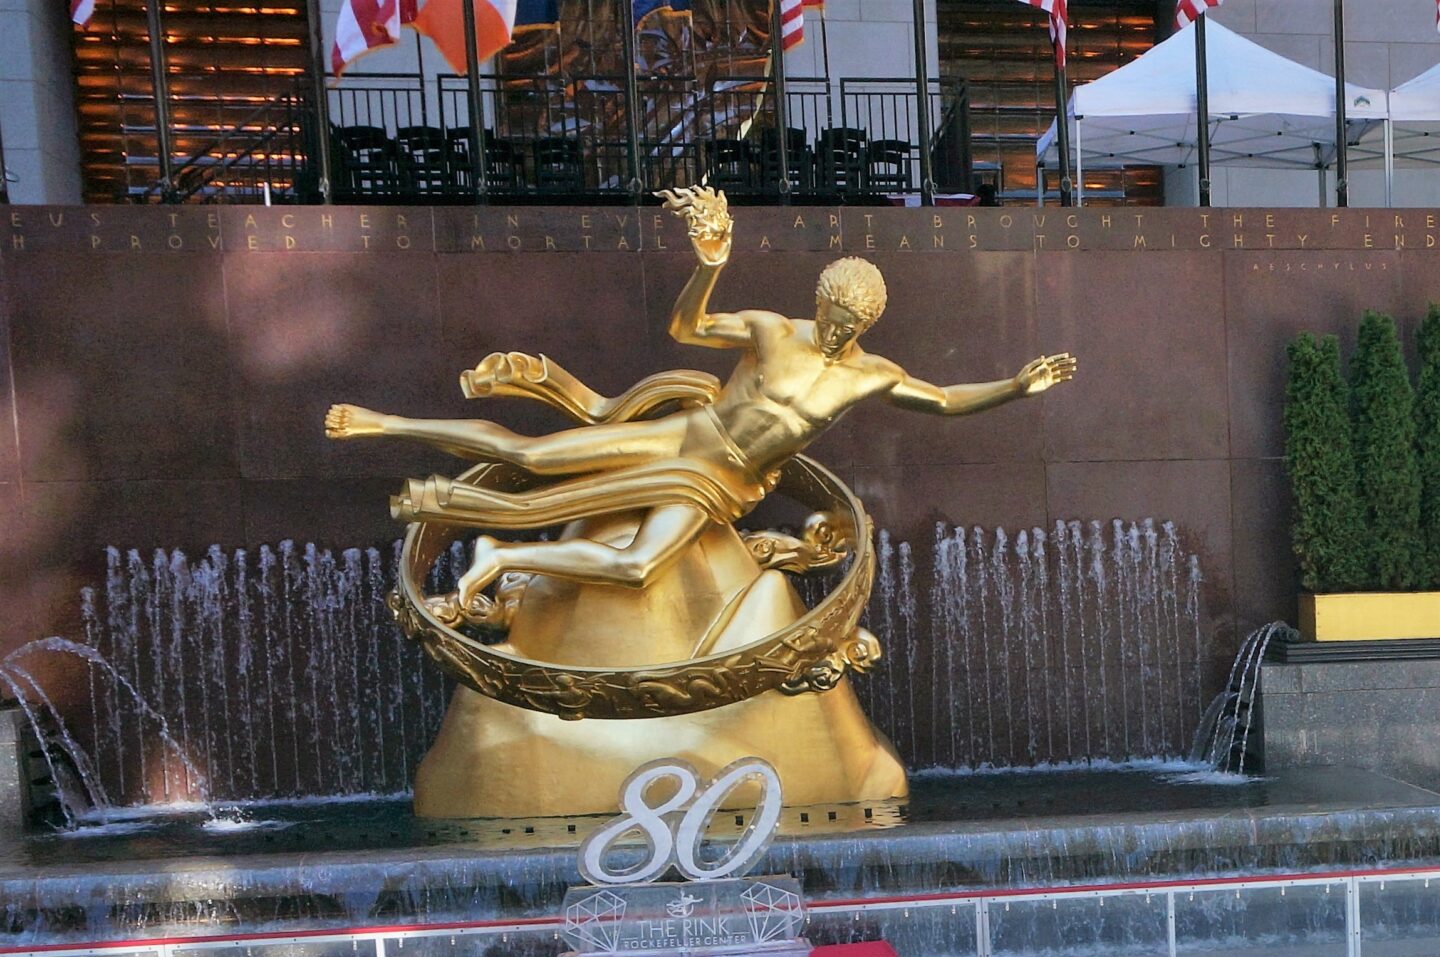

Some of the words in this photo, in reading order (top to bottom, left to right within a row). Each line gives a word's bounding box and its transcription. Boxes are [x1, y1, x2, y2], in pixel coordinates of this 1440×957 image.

[168, 213, 408, 228] TEACHER
[473, 214, 519, 228] IN
[581, 214, 664, 228] EVE
[794, 214, 873, 228] ART
[934, 214, 1143, 229] BROUGHT
[1201, 214, 1274, 228] THE
[1331, 214, 1435, 229] FIRE
[91, 235, 296, 250] PROVED
[361, 235, 411, 249] TO
[471, 235, 666, 249] MORTAL
[760, 235, 771, 248] A
[829, 235, 977, 249] MEANS
[1035, 235, 1080, 249] TO
[1134, 234, 1308, 248] MIGHTY
[1253, 262, 1387, 271] AESCHYLUS
[584, 764, 781, 883] 80
[638, 919, 677, 938] THE
[683, 917, 730, 936] RINK
[624, 938, 701, 949] ROCKEFELLER
[704, 935, 747, 945] CENTER
